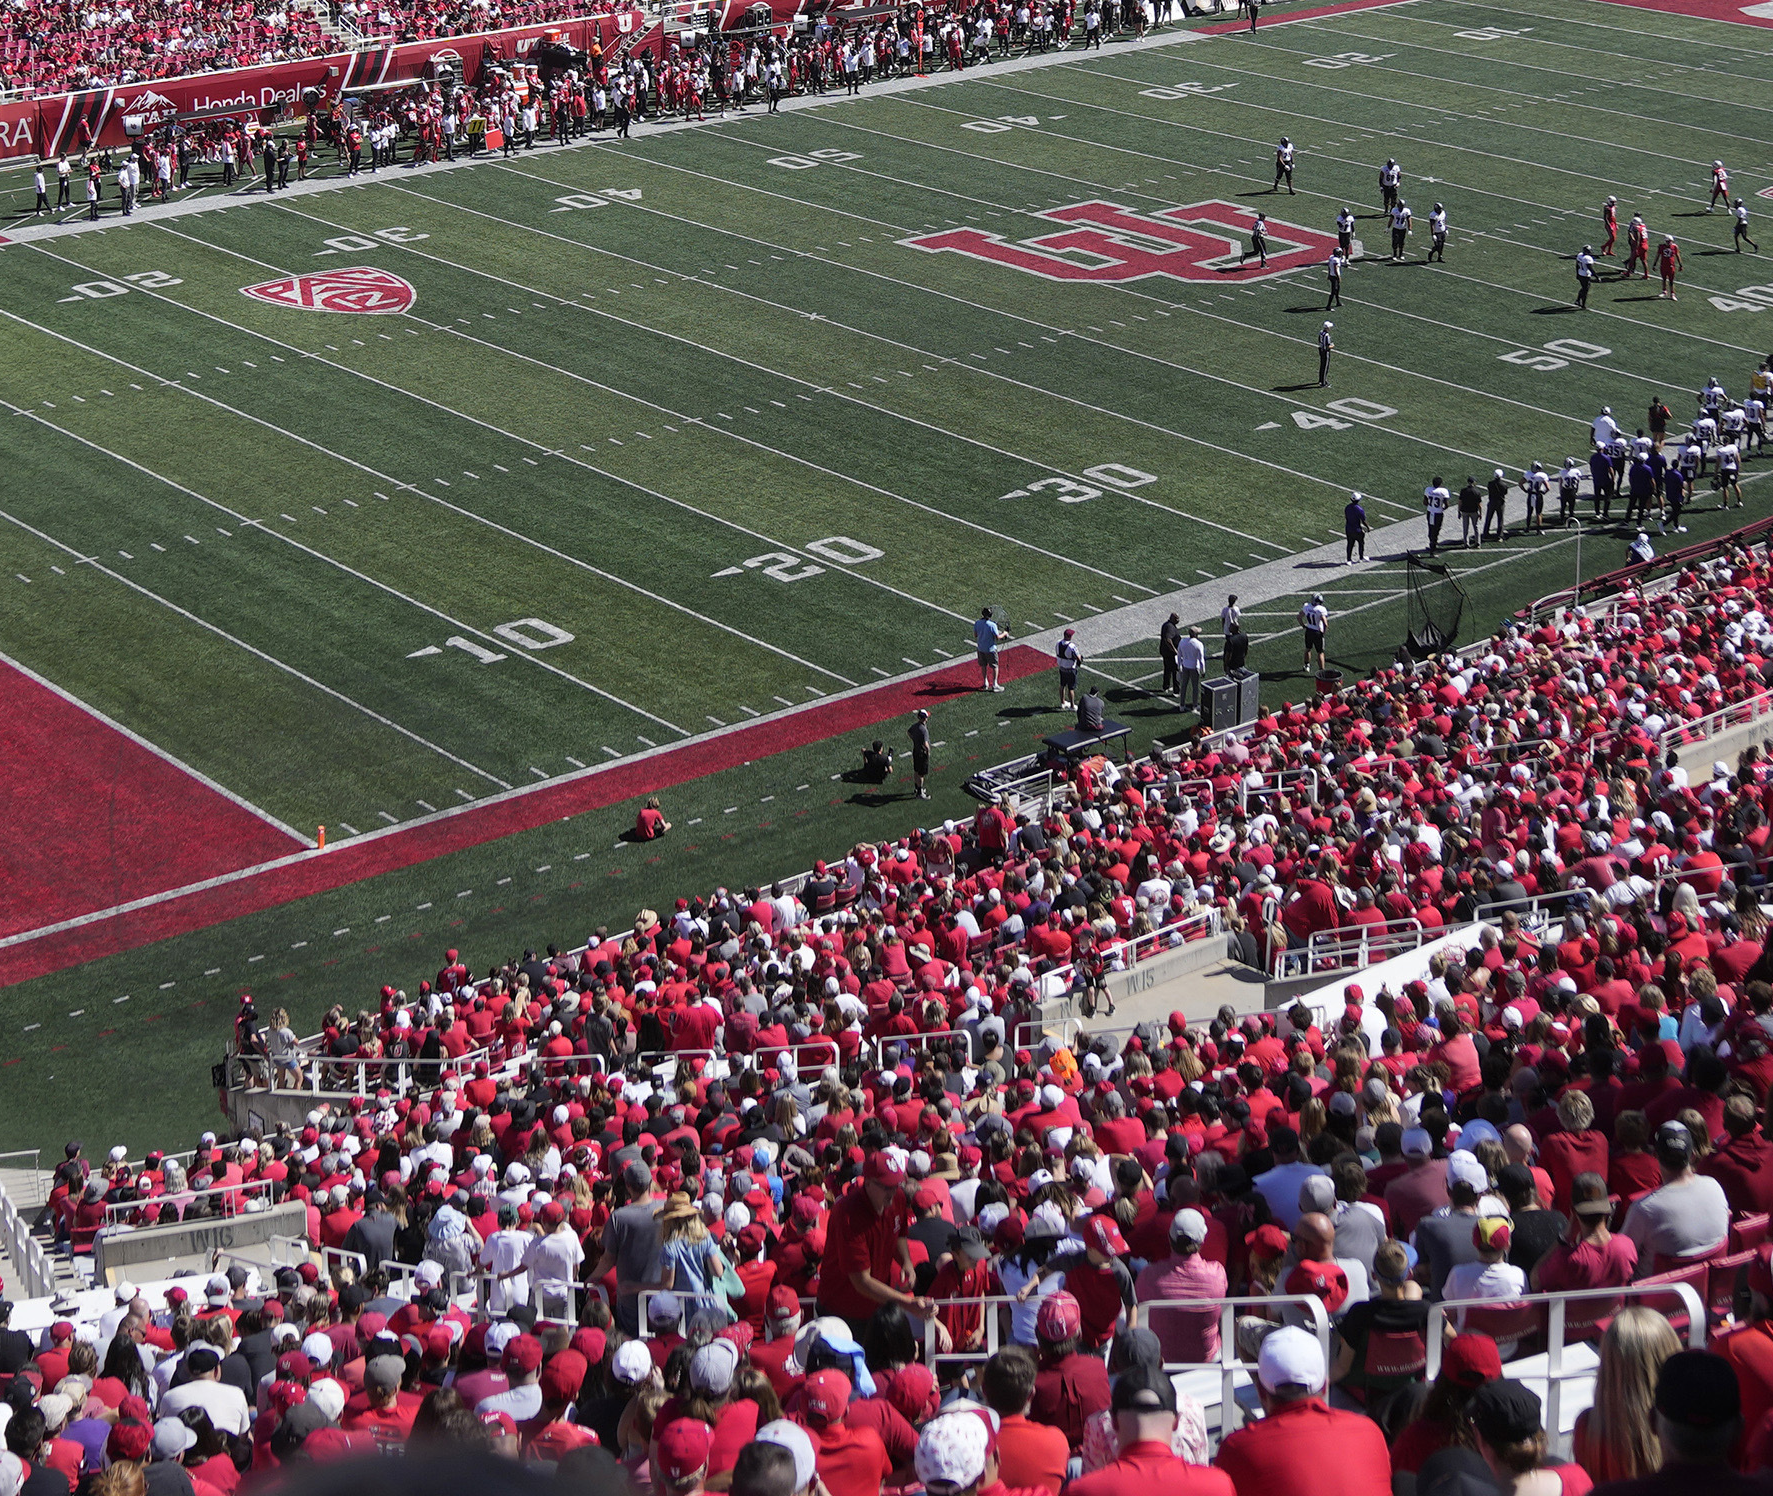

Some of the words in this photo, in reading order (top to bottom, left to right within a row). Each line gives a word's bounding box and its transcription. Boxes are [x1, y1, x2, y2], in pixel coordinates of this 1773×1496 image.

[1453, 26, 1522, 41] 10
[1302, 52, 1384, 69] 20
[193, 90, 256, 112] Honda
[1138, 82, 1224, 100] 30
[959, 115, 1040, 134] 40
[765, 148, 865, 170] 50
[555, 188, 643, 209] 40
[323, 226, 431, 254] 30
[72, 270, 184, 300] 20
[1496, 338, 1613, 372] 50
[1289, 397, 1399, 431] 40
[1025, 463, 1158, 504] 30
[1427, 497, 1441, 508] 73
[742, 535, 886, 583] 20
[445, 617, 576, 664] 10
